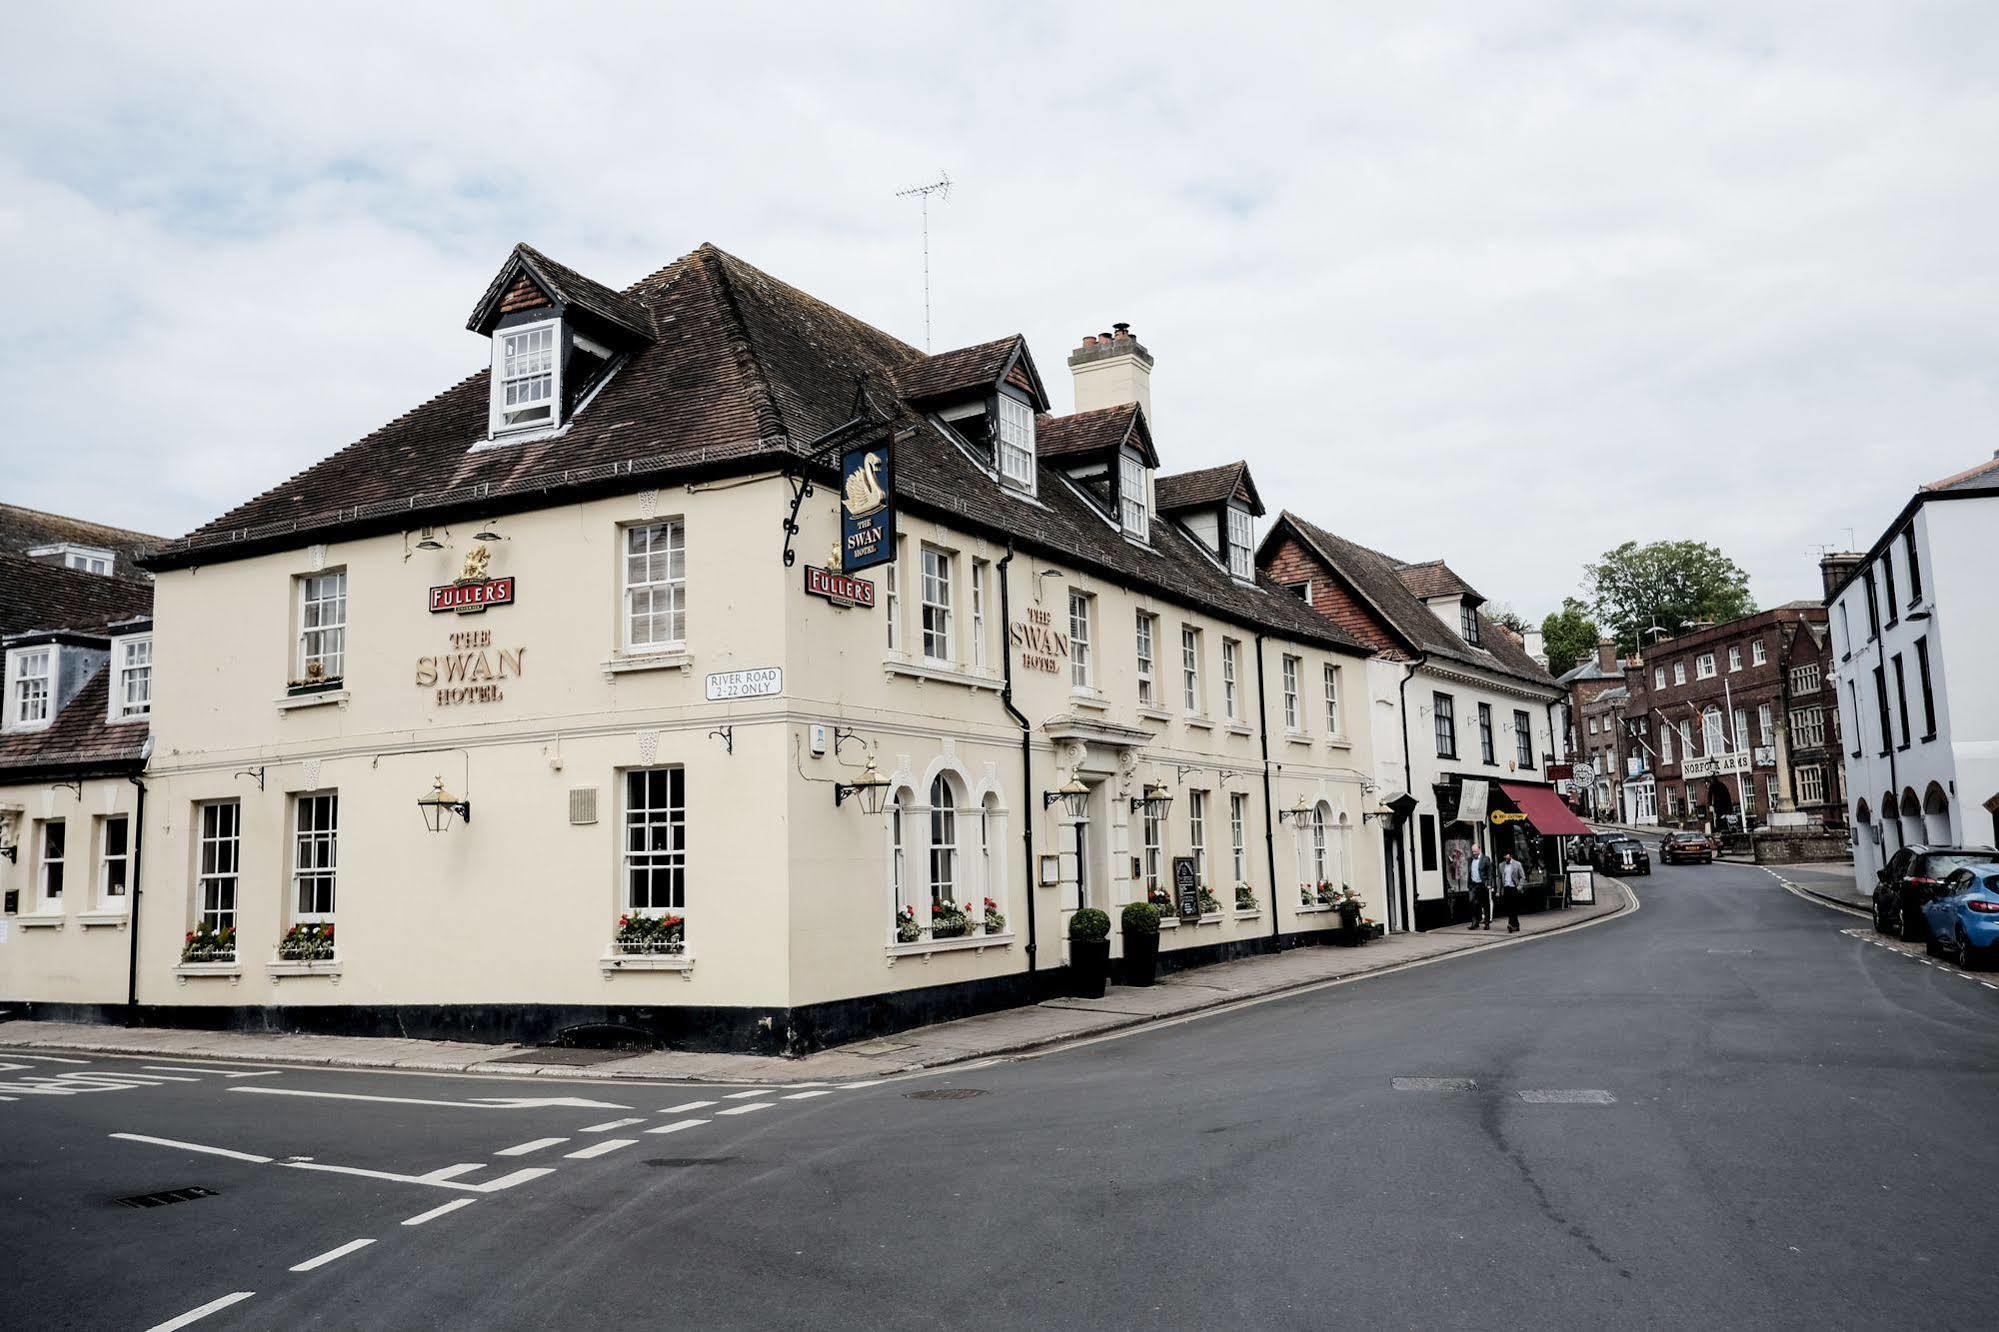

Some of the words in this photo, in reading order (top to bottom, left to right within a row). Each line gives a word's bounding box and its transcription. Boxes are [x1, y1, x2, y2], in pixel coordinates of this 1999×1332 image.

[857, 519, 871, 530] THE
[847, 527, 882, 549] SWAN
[854, 545, 877, 558] HOTEL
[434, 583, 506, 607] FULLER'S
[812, 570, 871, 601] FULLER'S
[1027, 607, 1052, 626] THE
[450, 629, 491, 649] THE
[1010, 621, 1068, 657] SWAN
[416, 646, 527, 687] SWAN
[1023, 653, 1060, 674] HOTEL
[711, 674, 742, 686] RIVER
[746, 670, 776, 682] ROAD
[437, 685, 504, 705] HOTEL
[717, 686, 738, 697] 2-22
[741, 682, 770, 694] ONLY
[1684, 760, 1721, 775] NORFOK
